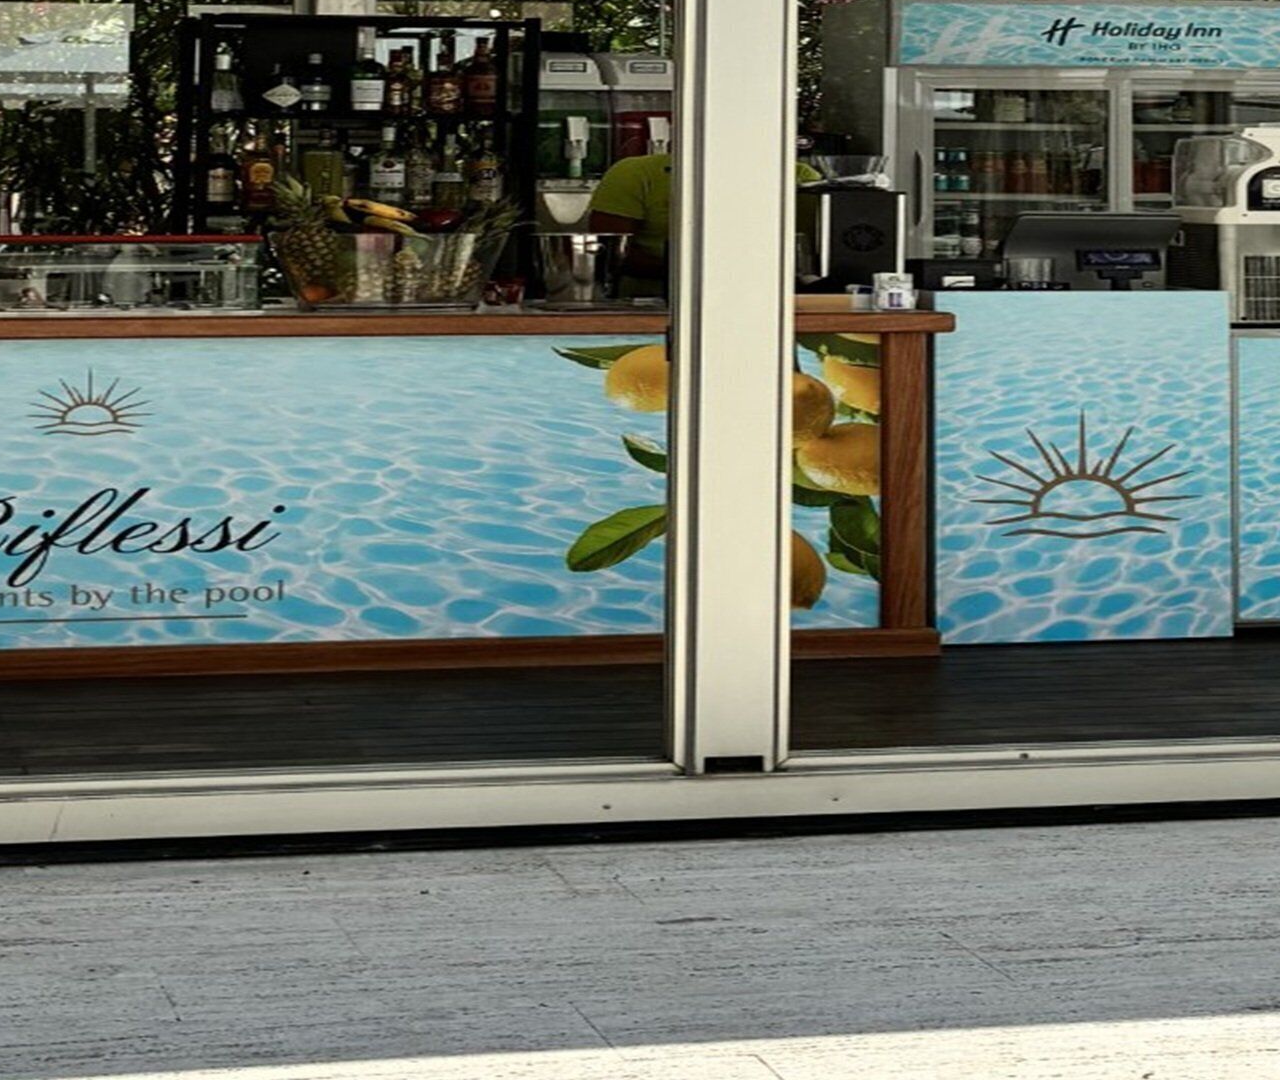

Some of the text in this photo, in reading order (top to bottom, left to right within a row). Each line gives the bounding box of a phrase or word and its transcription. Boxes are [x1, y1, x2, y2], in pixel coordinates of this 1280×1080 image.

[1090, 21, 1183, 41] Holiday
[1184, 22, 1222, 38] Inn
[1127, 42, 1181, 51] BY IHG
[69, 583, 113, 610] by
[130, 581, 189, 605] the
[204, 579, 286, 608] pool
